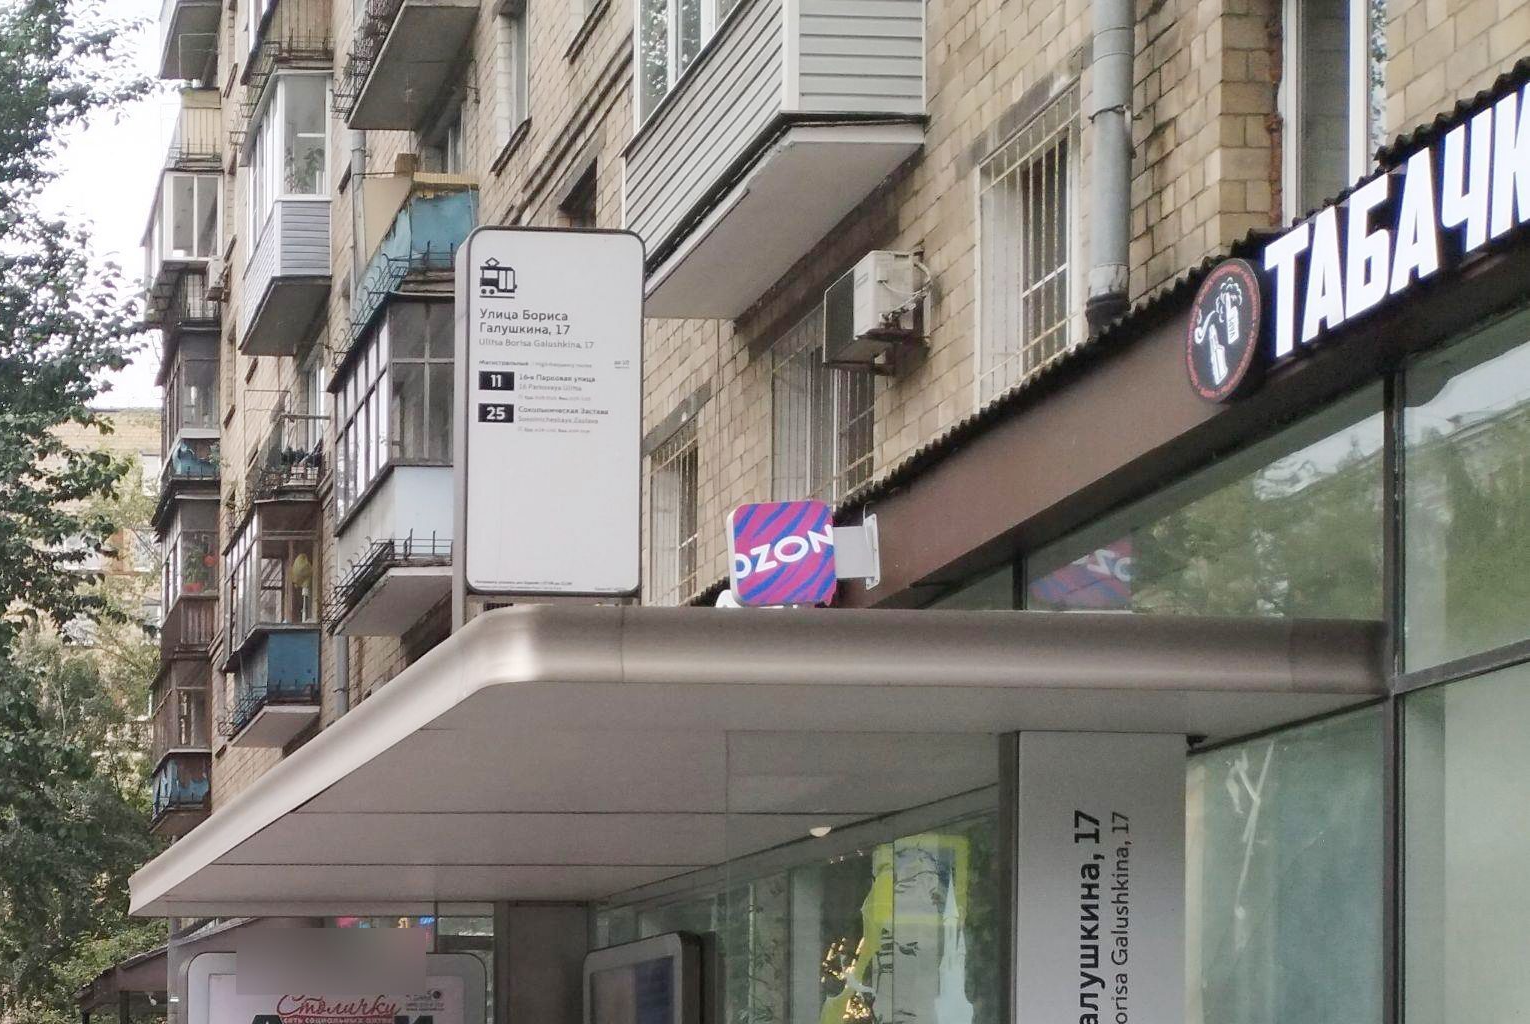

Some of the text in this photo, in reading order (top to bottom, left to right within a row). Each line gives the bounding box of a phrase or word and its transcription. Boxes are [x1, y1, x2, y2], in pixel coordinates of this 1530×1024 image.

[479, 308, 568, 322] Улица Бориса
[479, 322, 571, 335] Галушкина, 17
[585, 341, 594, 349] 17
[490, 374, 502, 388] 11
[486, 406, 506, 421] 25
[734, 524, 833, 579] OZON
[1073, 810, 1101, 844] 17
[1111, 811, 1130, 834] 17
[1110, 840, 1132, 966] Galushkina,
